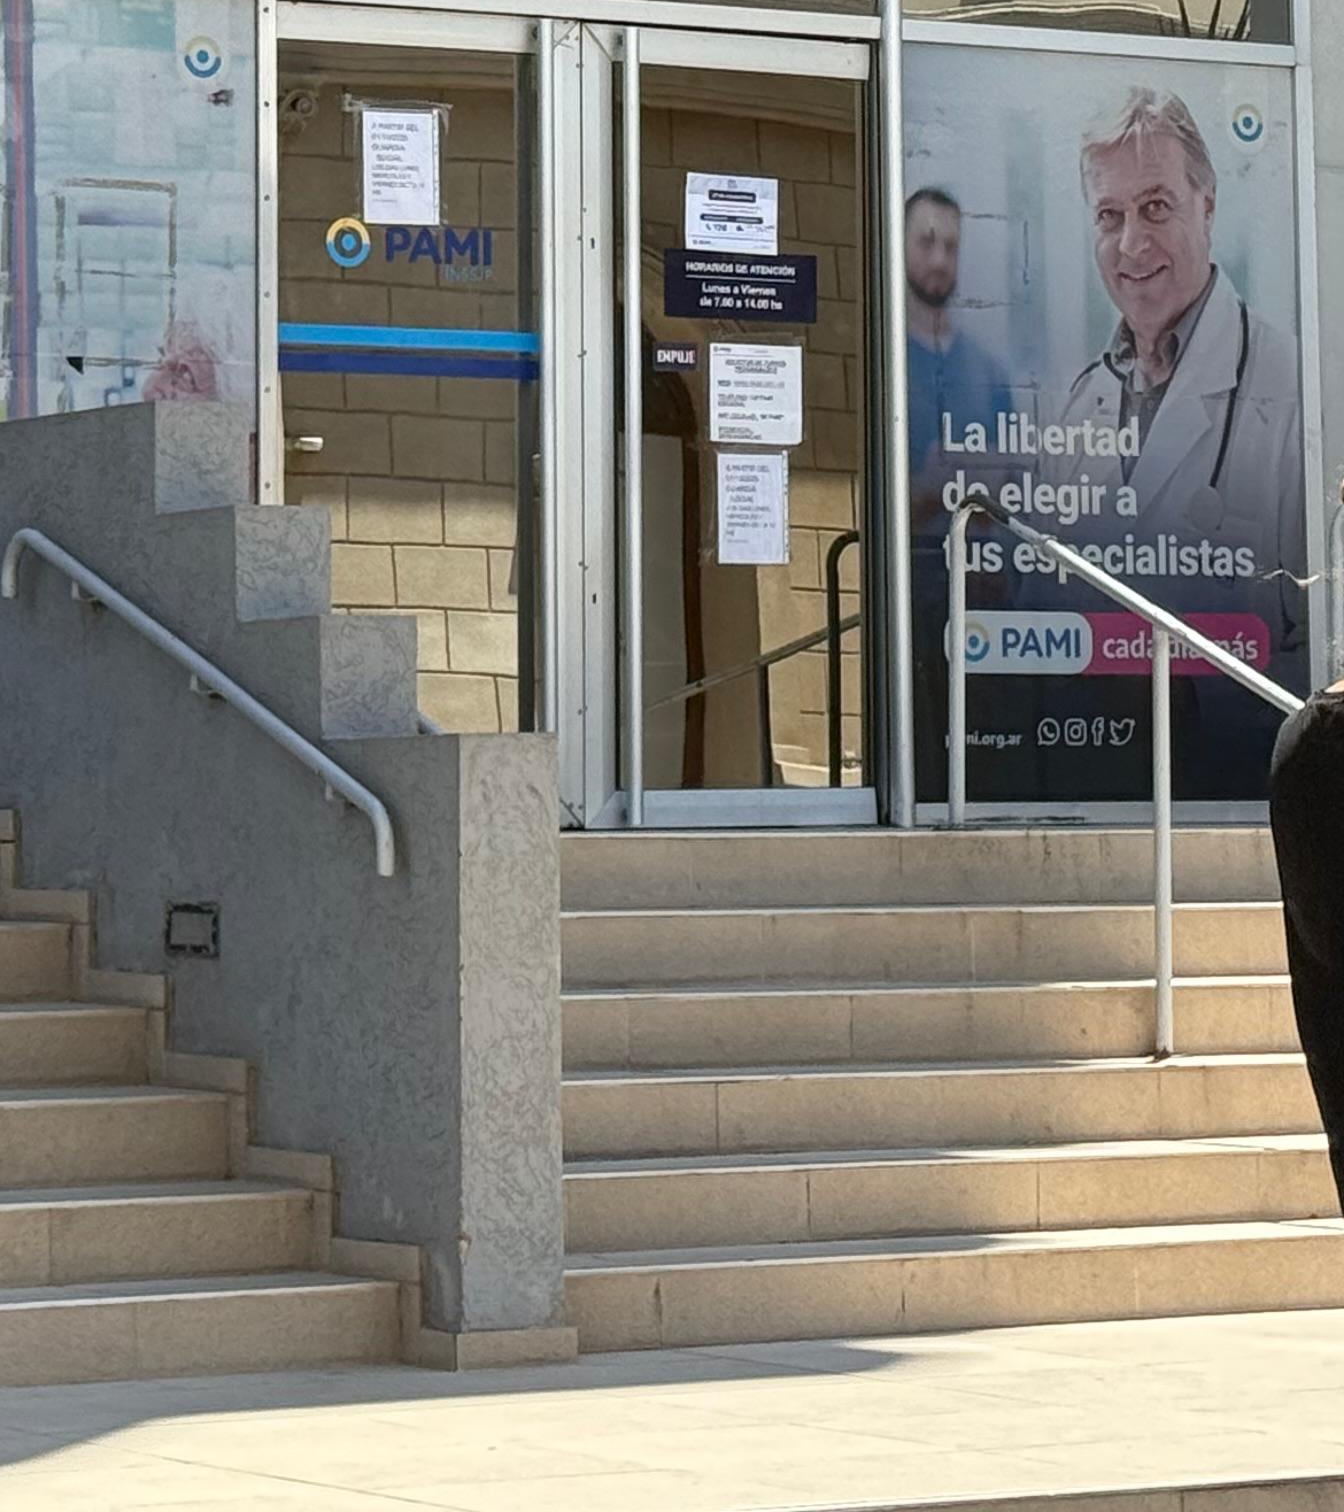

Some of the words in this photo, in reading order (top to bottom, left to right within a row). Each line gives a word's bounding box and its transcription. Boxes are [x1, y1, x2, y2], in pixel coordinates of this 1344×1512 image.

[385, 226, 492, 266] PAMI
[699, 295, 712, 307] de
[701, 281, 731, 294] Lunes
[741, 284, 777, 296] Viernes
[942, 412, 986, 454] La
[997, 412, 1140, 457] libertad
[1000, 472, 1106, 525] elegir
[1115, 485, 1137, 516] a
[1001, 627, 1081, 658] PAMI
[945, 730, 1022, 749] mi.org.ar
